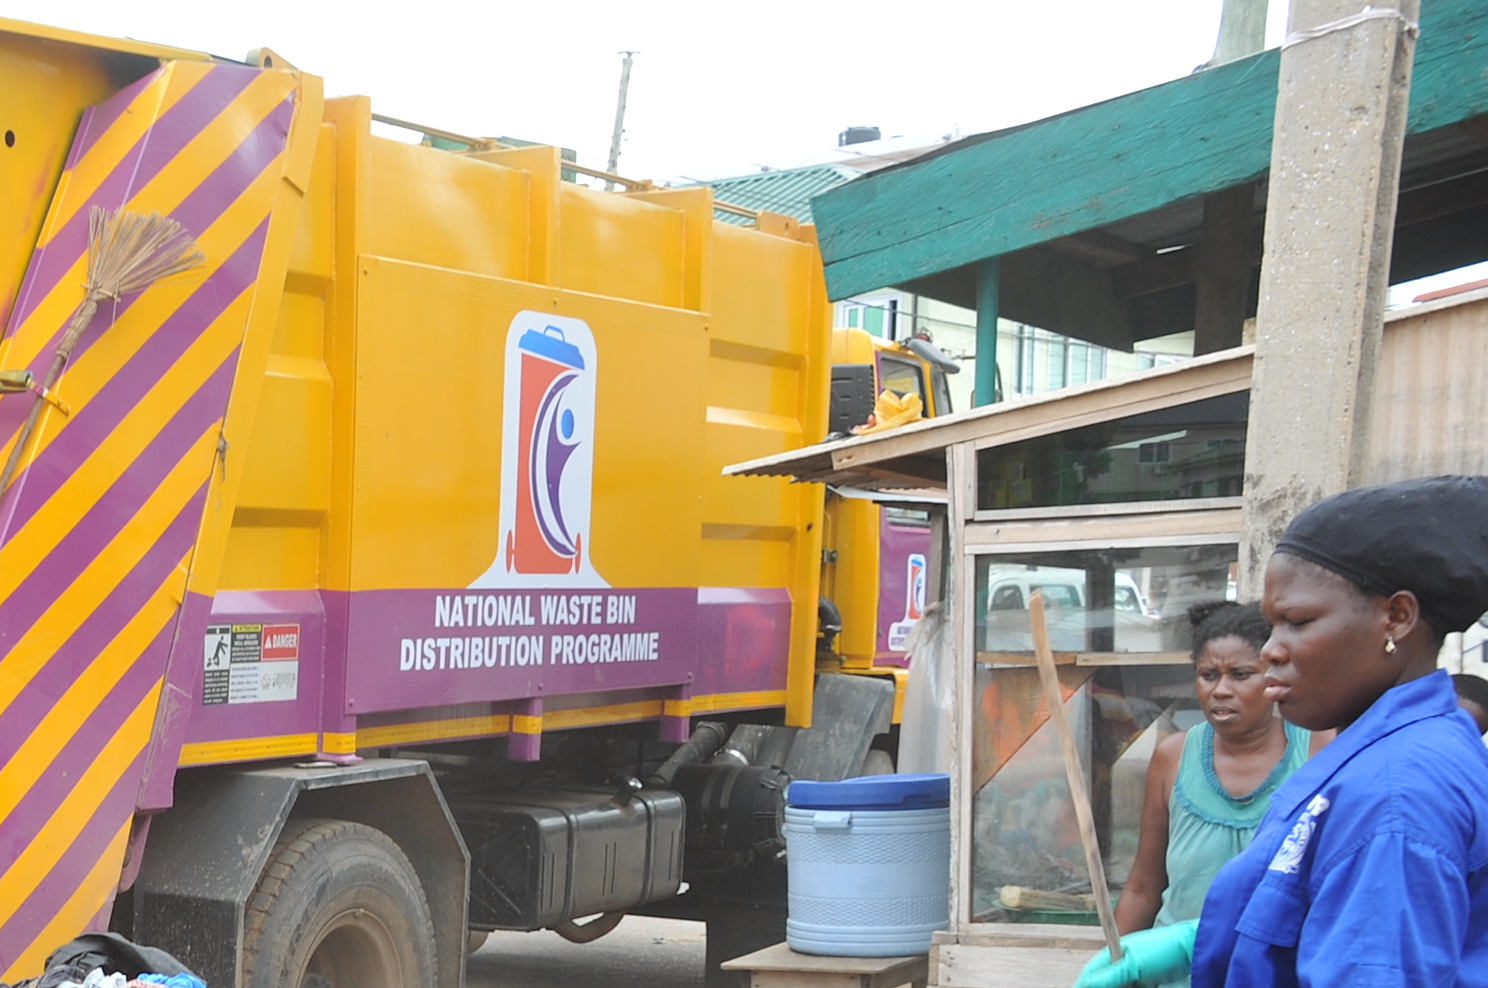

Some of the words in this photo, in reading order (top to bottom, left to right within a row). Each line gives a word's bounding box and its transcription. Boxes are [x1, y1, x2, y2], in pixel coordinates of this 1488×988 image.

[435, 595, 535, 628] NATIONAL
[540, 595, 602, 625] WASTE
[606, 595, 636, 625] BIN
[272, 633, 298, 648] DANGER
[400, 635, 543, 671] DISTRIBUTION
[551, 632, 659, 665] PROGRAMME
